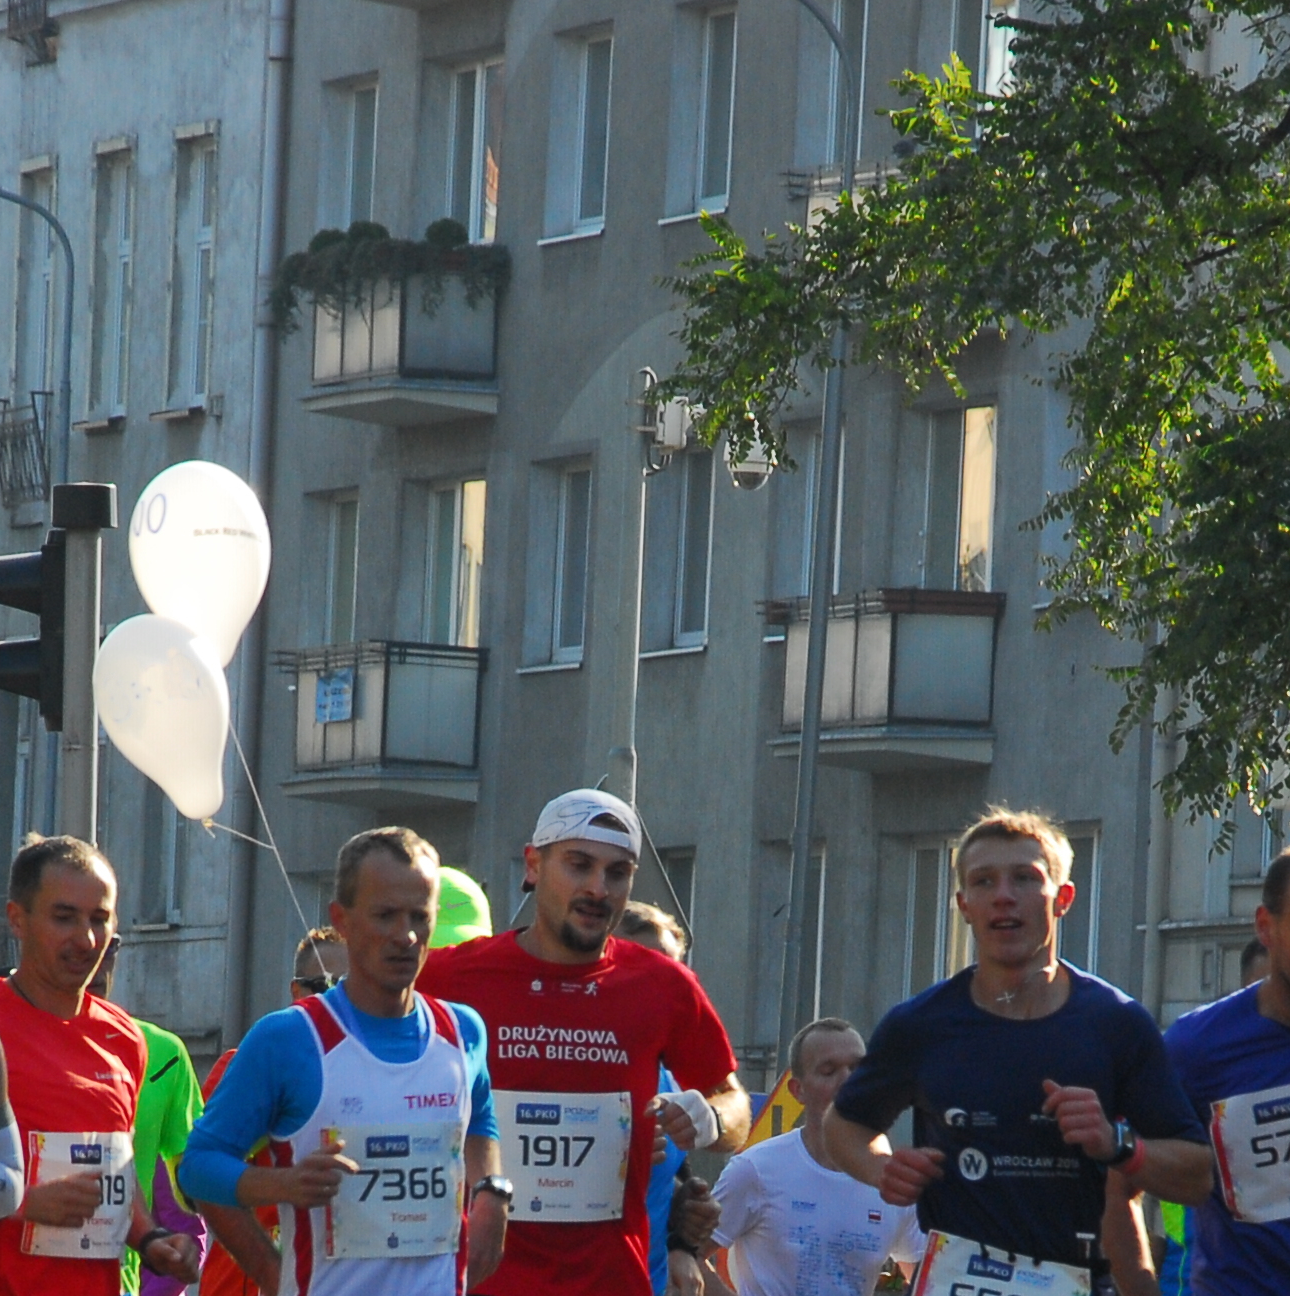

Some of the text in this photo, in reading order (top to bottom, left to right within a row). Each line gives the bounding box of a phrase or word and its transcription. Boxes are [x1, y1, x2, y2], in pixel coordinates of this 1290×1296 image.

[498, 1025, 618, 1045] DRUŻYNOWA
[498, 1044, 629, 1065] LIGA BIEGOWA
[404, 1093, 458, 1110] TIMEX
[520, 1109, 557, 1119] 16. PKO
[386, 1141, 407, 1151] PKO
[518, 1134, 596, 1168] 1917
[992, 1156, 1054, 1168] WROCŁAW
[100, 1174, 126, 1206] 19
[357, 1166, 447, 1202] 7366
[538, 1178, 574, 1188] Marcin
[987, 1265, 1009, 1278] PKO
